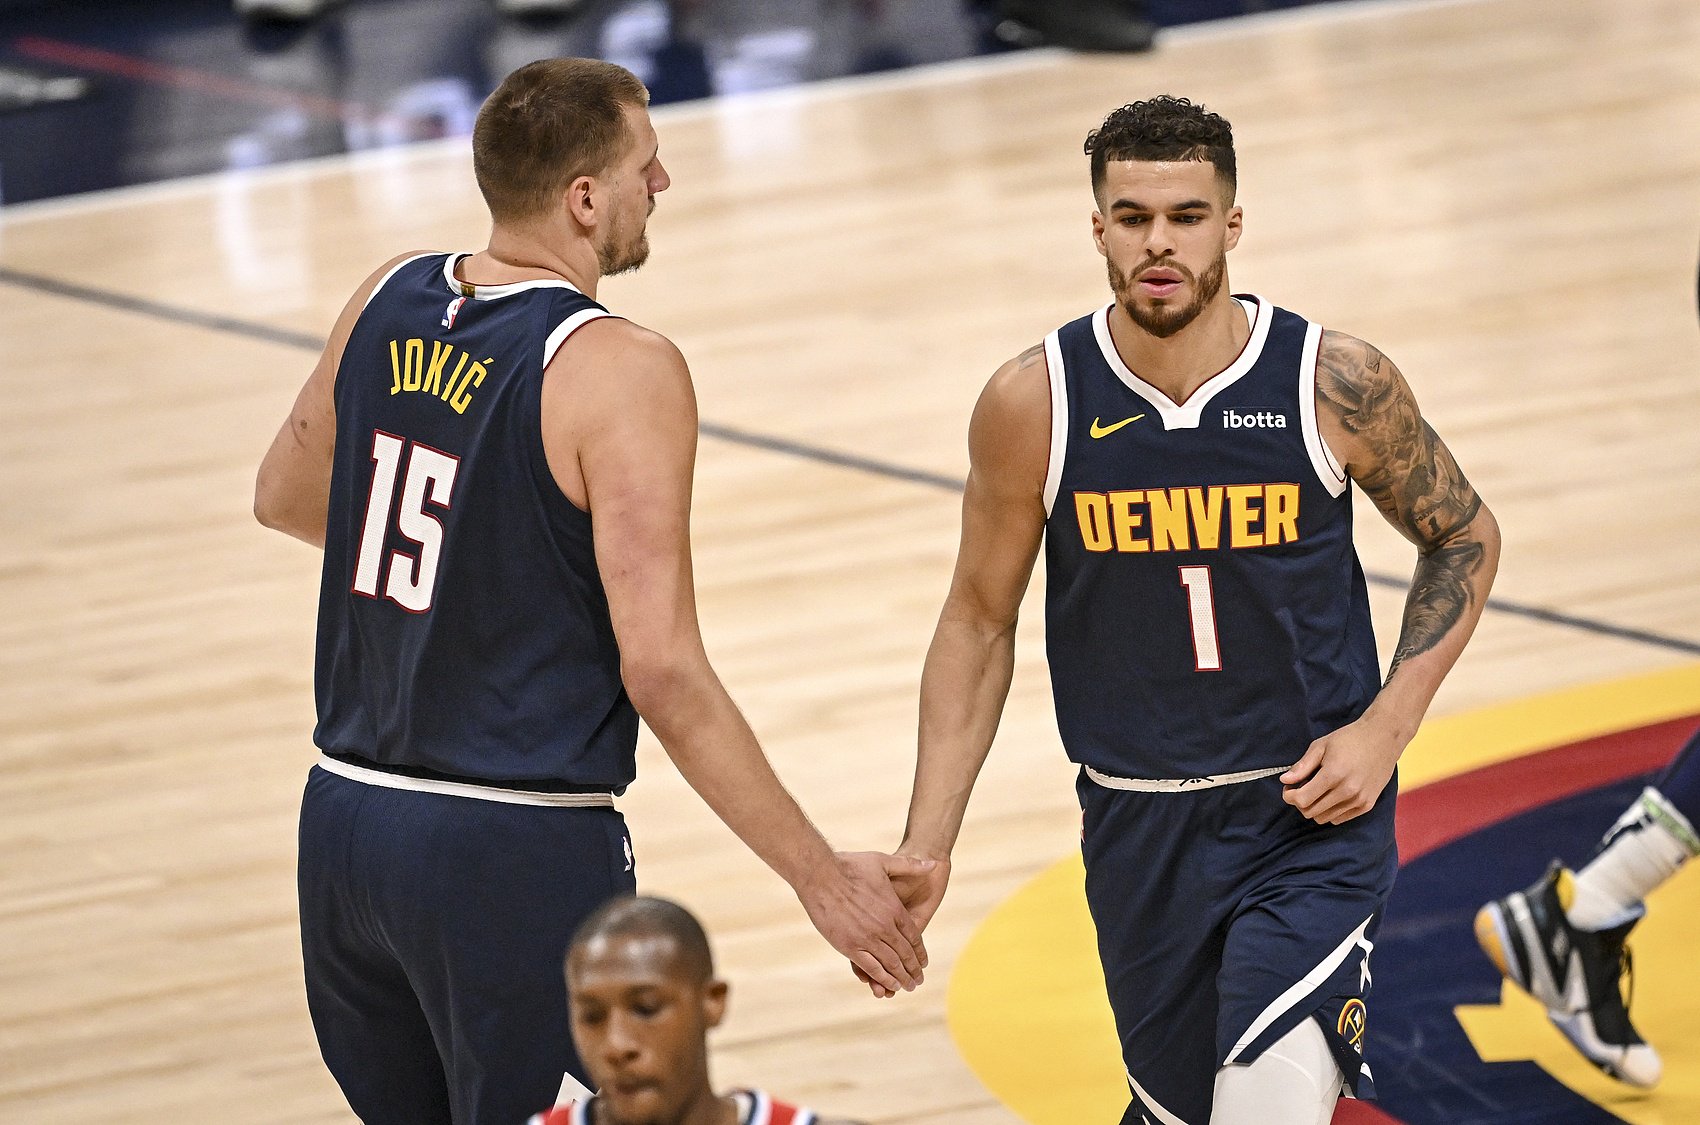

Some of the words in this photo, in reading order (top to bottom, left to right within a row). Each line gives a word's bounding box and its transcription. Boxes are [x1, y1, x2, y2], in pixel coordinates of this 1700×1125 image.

[389, 338, 494, 414] JOKIĆ
[1223, 410, 1287, 428] ibotta
[352, 429, 461, 614] 15
[1073, 483, 1300, 552] DENVER
[1178, 566, 1222, 671] 1
